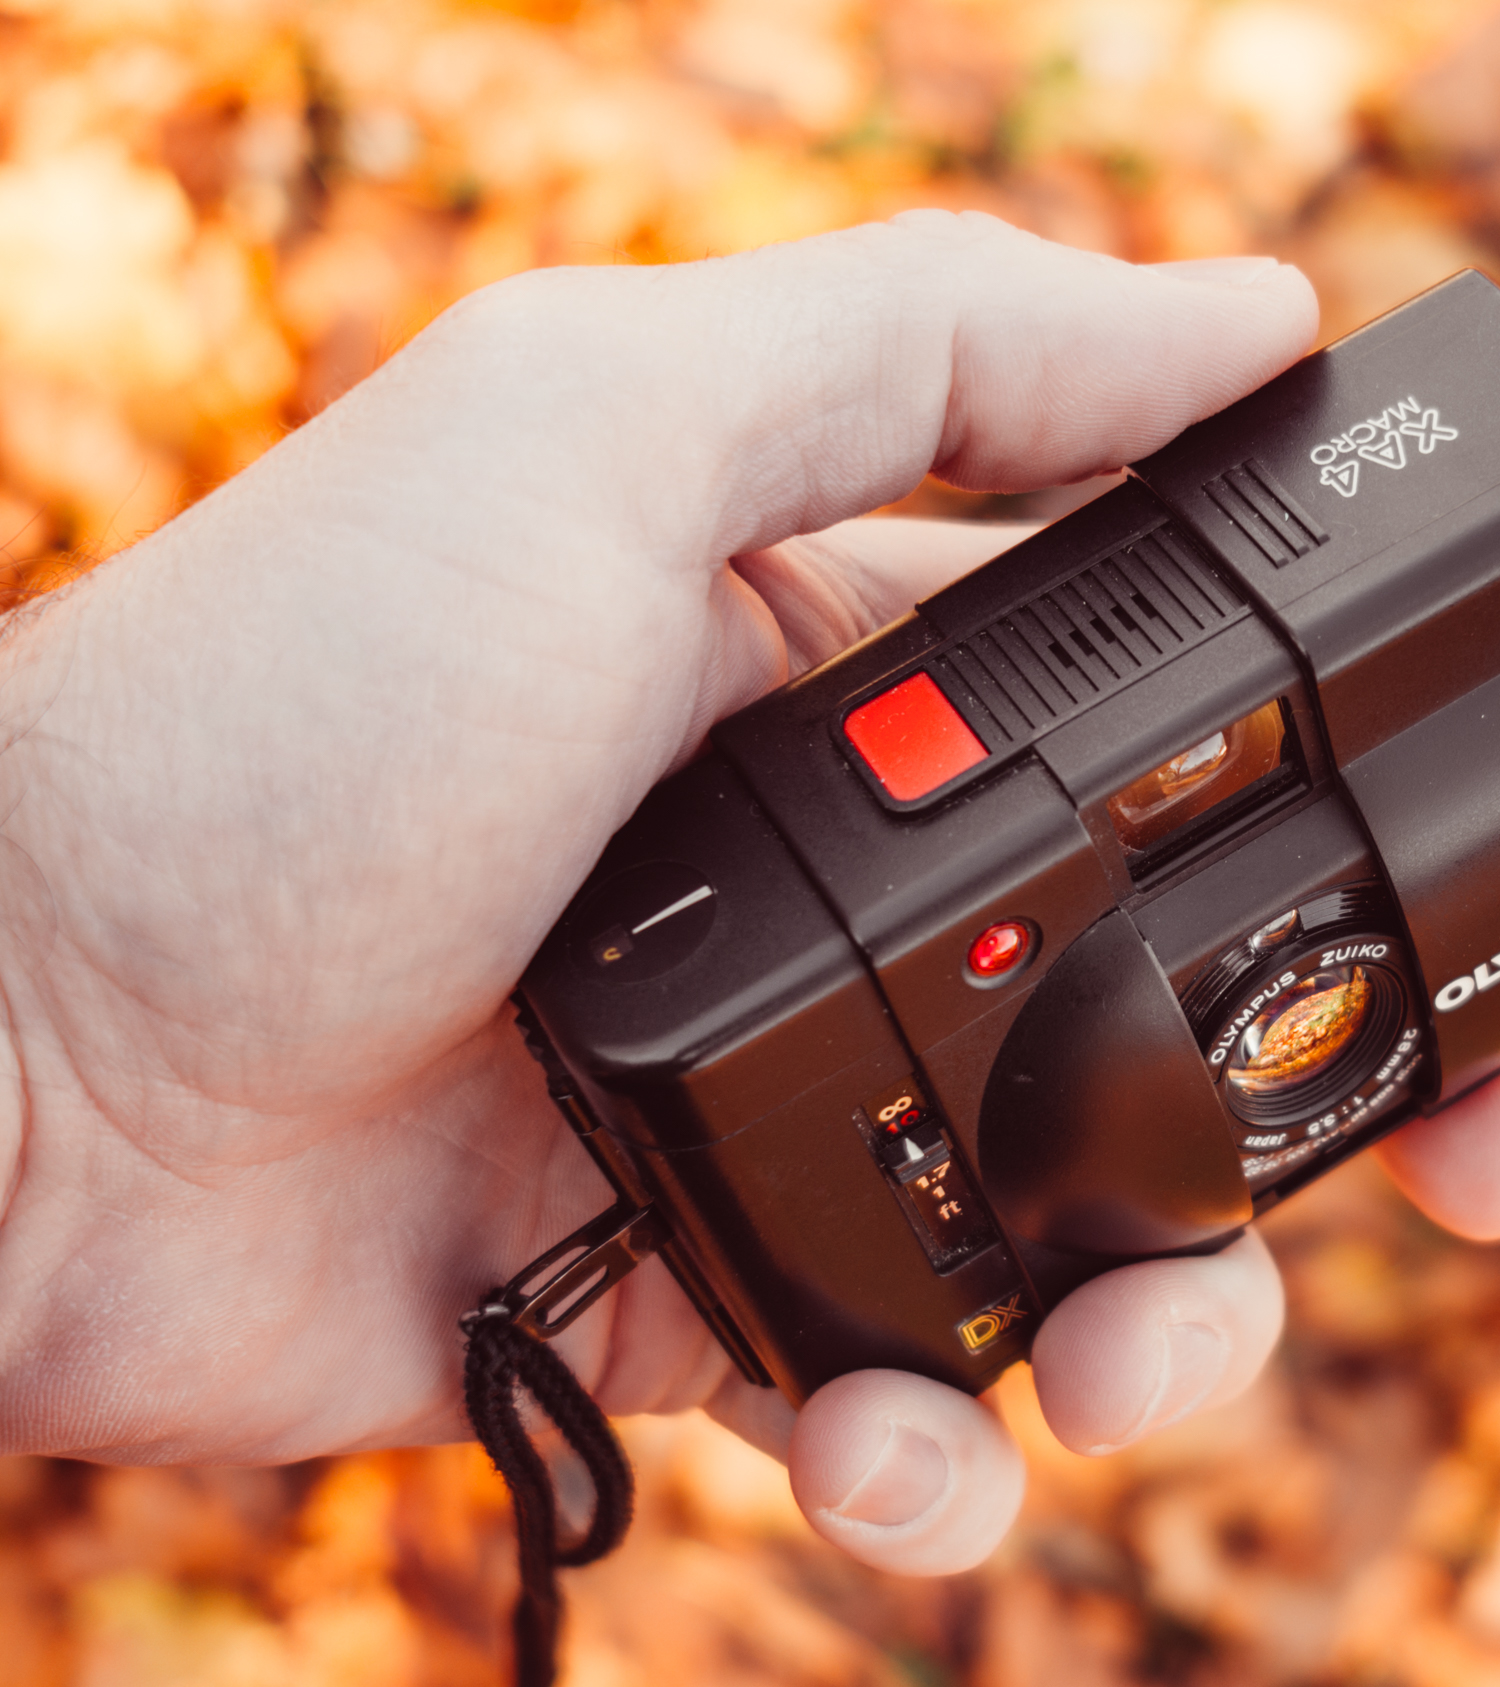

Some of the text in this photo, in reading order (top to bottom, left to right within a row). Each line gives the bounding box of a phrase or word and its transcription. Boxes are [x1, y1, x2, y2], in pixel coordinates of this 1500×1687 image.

[1311, 396, 1421, 465] MACRO
[1320, 409, 1458, 498] XA4
[1210, 971, 1297, 1064] OLYMPUS
[1320, 944, 1388, 967] ZUIKO
[886, 1109, 919, 1134] 10
[916, 1160, 951, 1189] 1.7
[932, 1185, 946, 1198] 1
[939, 1200, 962, 1220] ft
[962, 1293, 1028, 1348] DX
